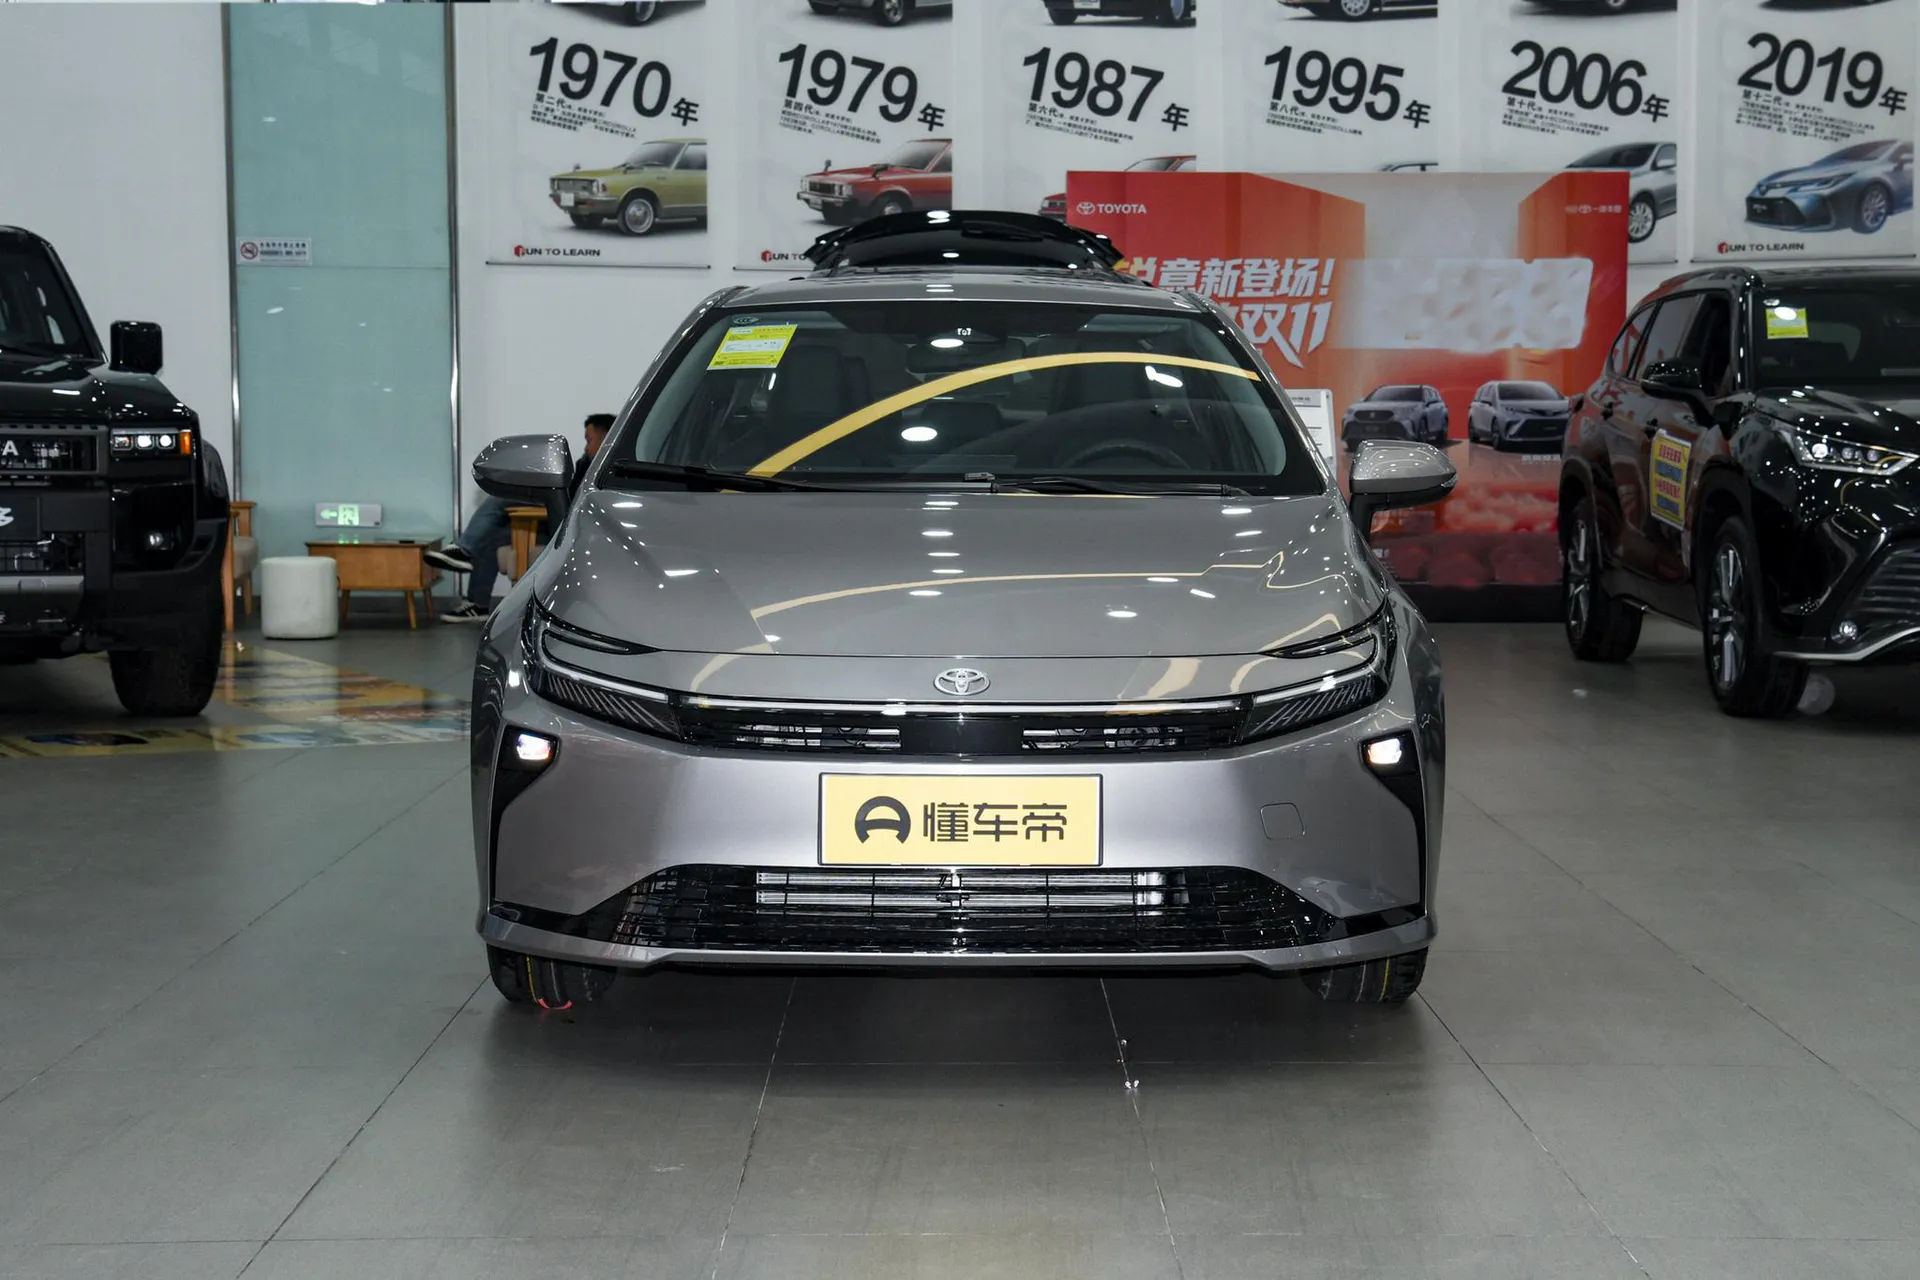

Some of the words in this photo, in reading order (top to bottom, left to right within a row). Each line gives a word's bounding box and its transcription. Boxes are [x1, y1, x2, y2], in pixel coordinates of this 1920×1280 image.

[530, 37, 700, 127] 1970年
[779, 44, 946, 132] 1979年
[1023, 47, 1189, 131] 1987年
[1264, 46, 1431, 128] 1995年
[1502, 40, 1670, 122] 2006年
[1737, 33, 1908, 116] 2019年
[1097, 203, 1147, 214] TOYOTA
[545, 248, 561, 256] TO
[563, 248, 601, 256] LEARN
[791, 253, 808, 261] TO
[1749, 243, 1764, 252] TO
[1766, 243, 1804, 252] LEARN
[1220, 301, 1334, 369] 双11
[922, 802, 1067, 843] 懂车帝
